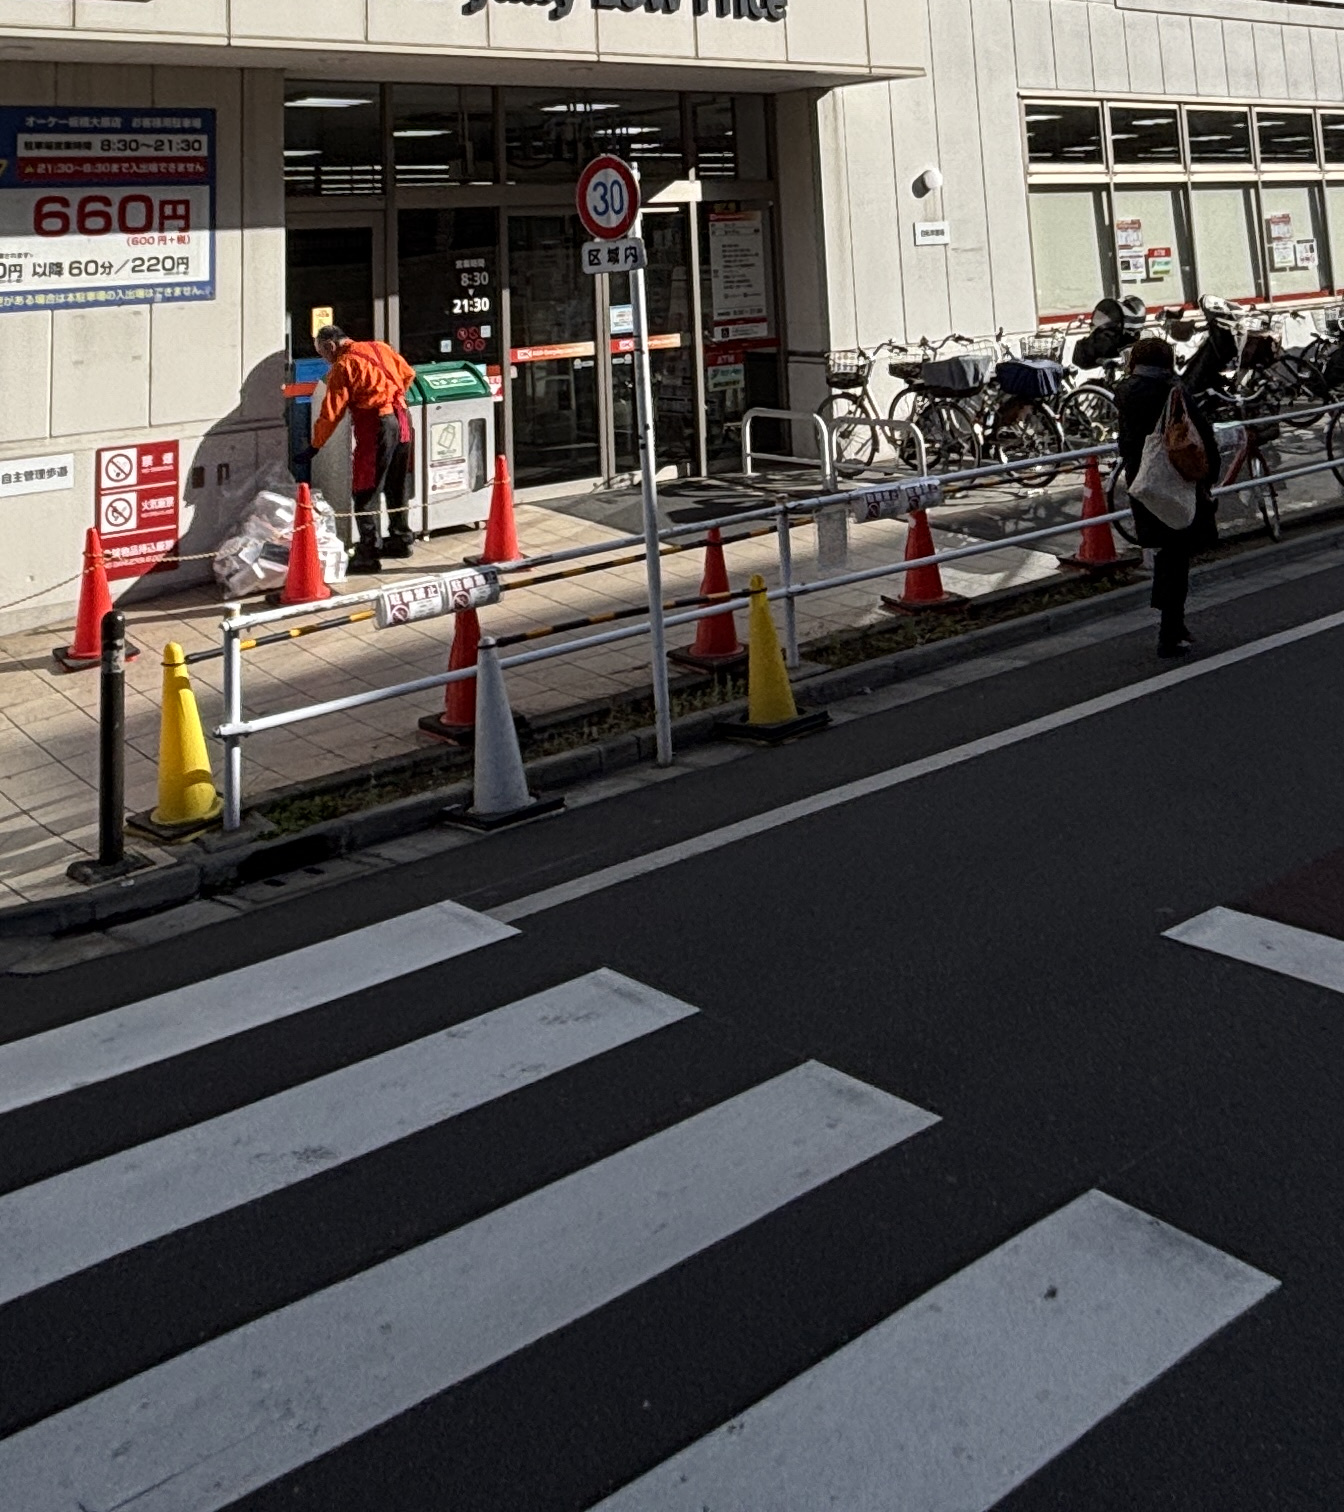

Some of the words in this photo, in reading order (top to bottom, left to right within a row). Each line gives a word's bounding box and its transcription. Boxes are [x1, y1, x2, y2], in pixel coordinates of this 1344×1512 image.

[592, 179, 624, 216] 30
[33, 194, 191, 238] 660円
[588, 246, 639, 266] 区域内
[460, 271, 489, 286] 8:30
[452, 297, 491, 314] 21:30
[717, 354, 736, 364] ATM
